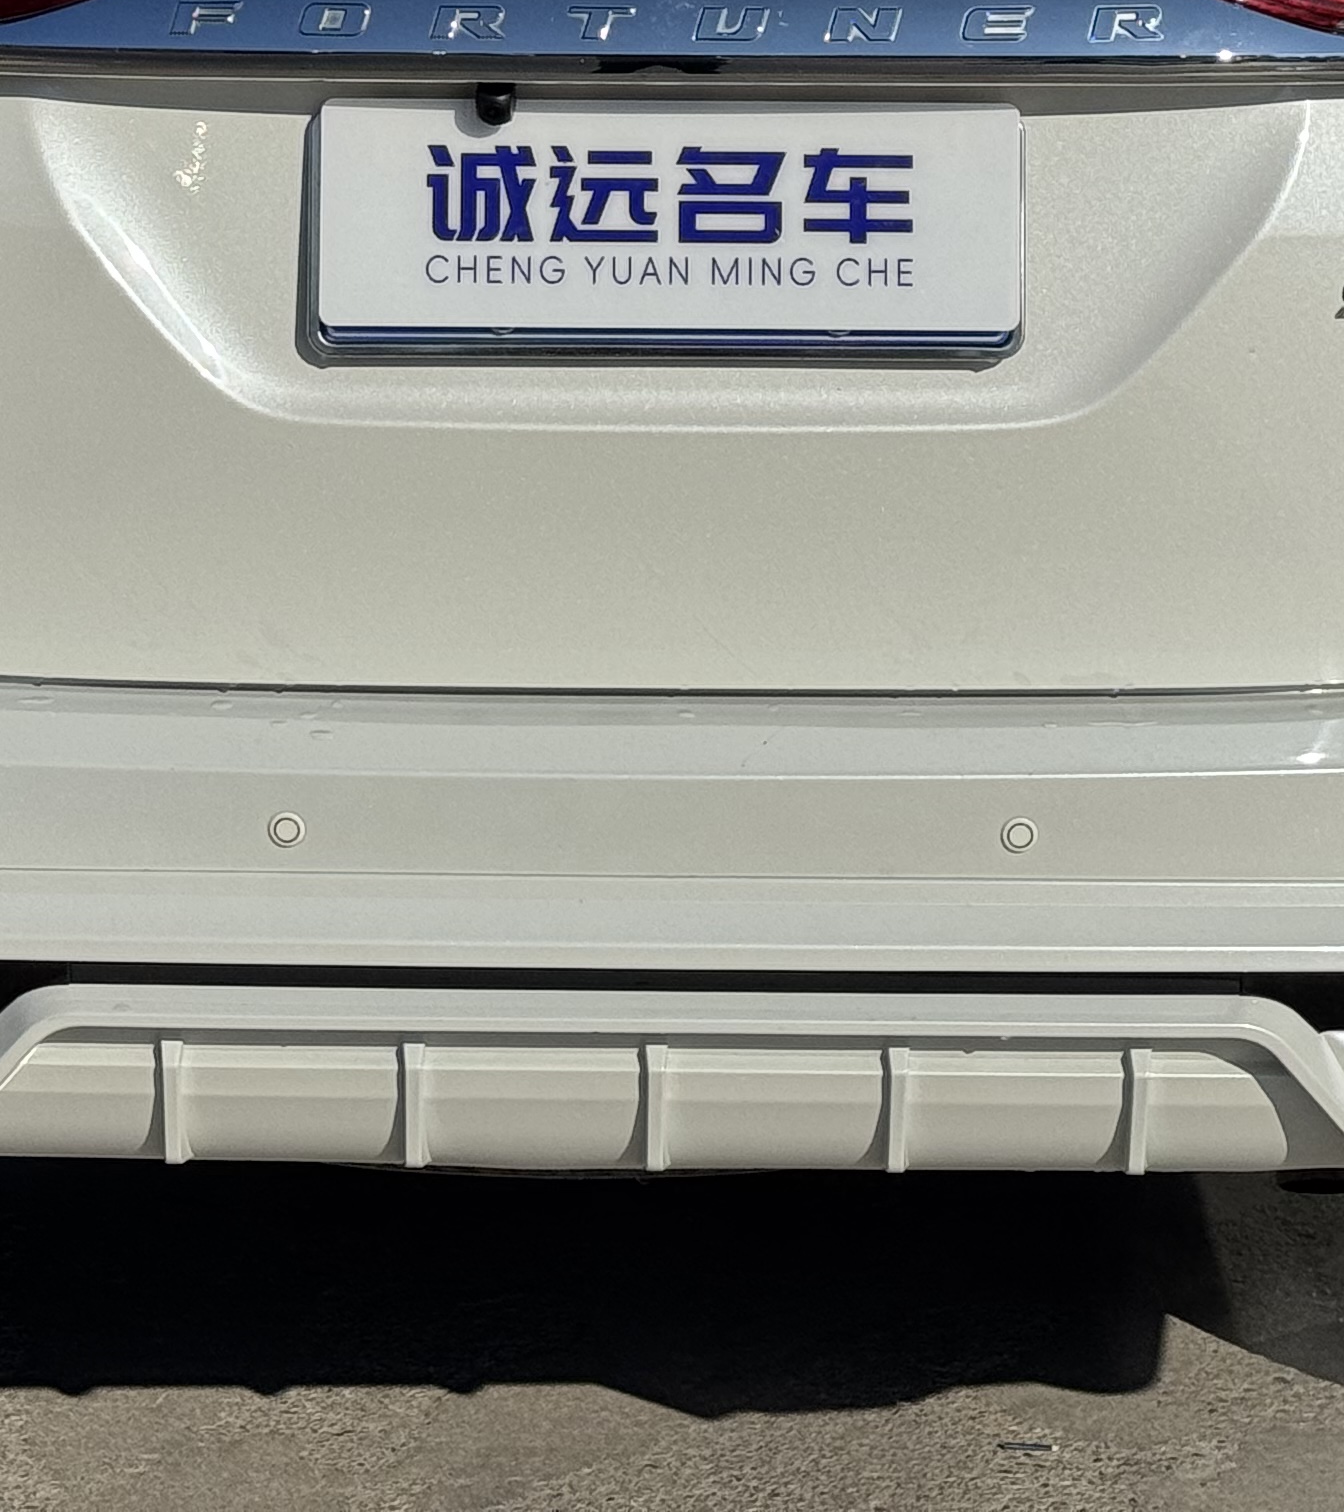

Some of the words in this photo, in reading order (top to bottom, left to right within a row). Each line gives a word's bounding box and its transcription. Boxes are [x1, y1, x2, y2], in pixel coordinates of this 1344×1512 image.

[425, 144, 915, 245] 诚远名车
[425, 254, 567, 286] CHENG
[584, 255, 691, 286] YUAN
[710, 257, 817, 287] MING
[835, 258, 915, 288] CHE
